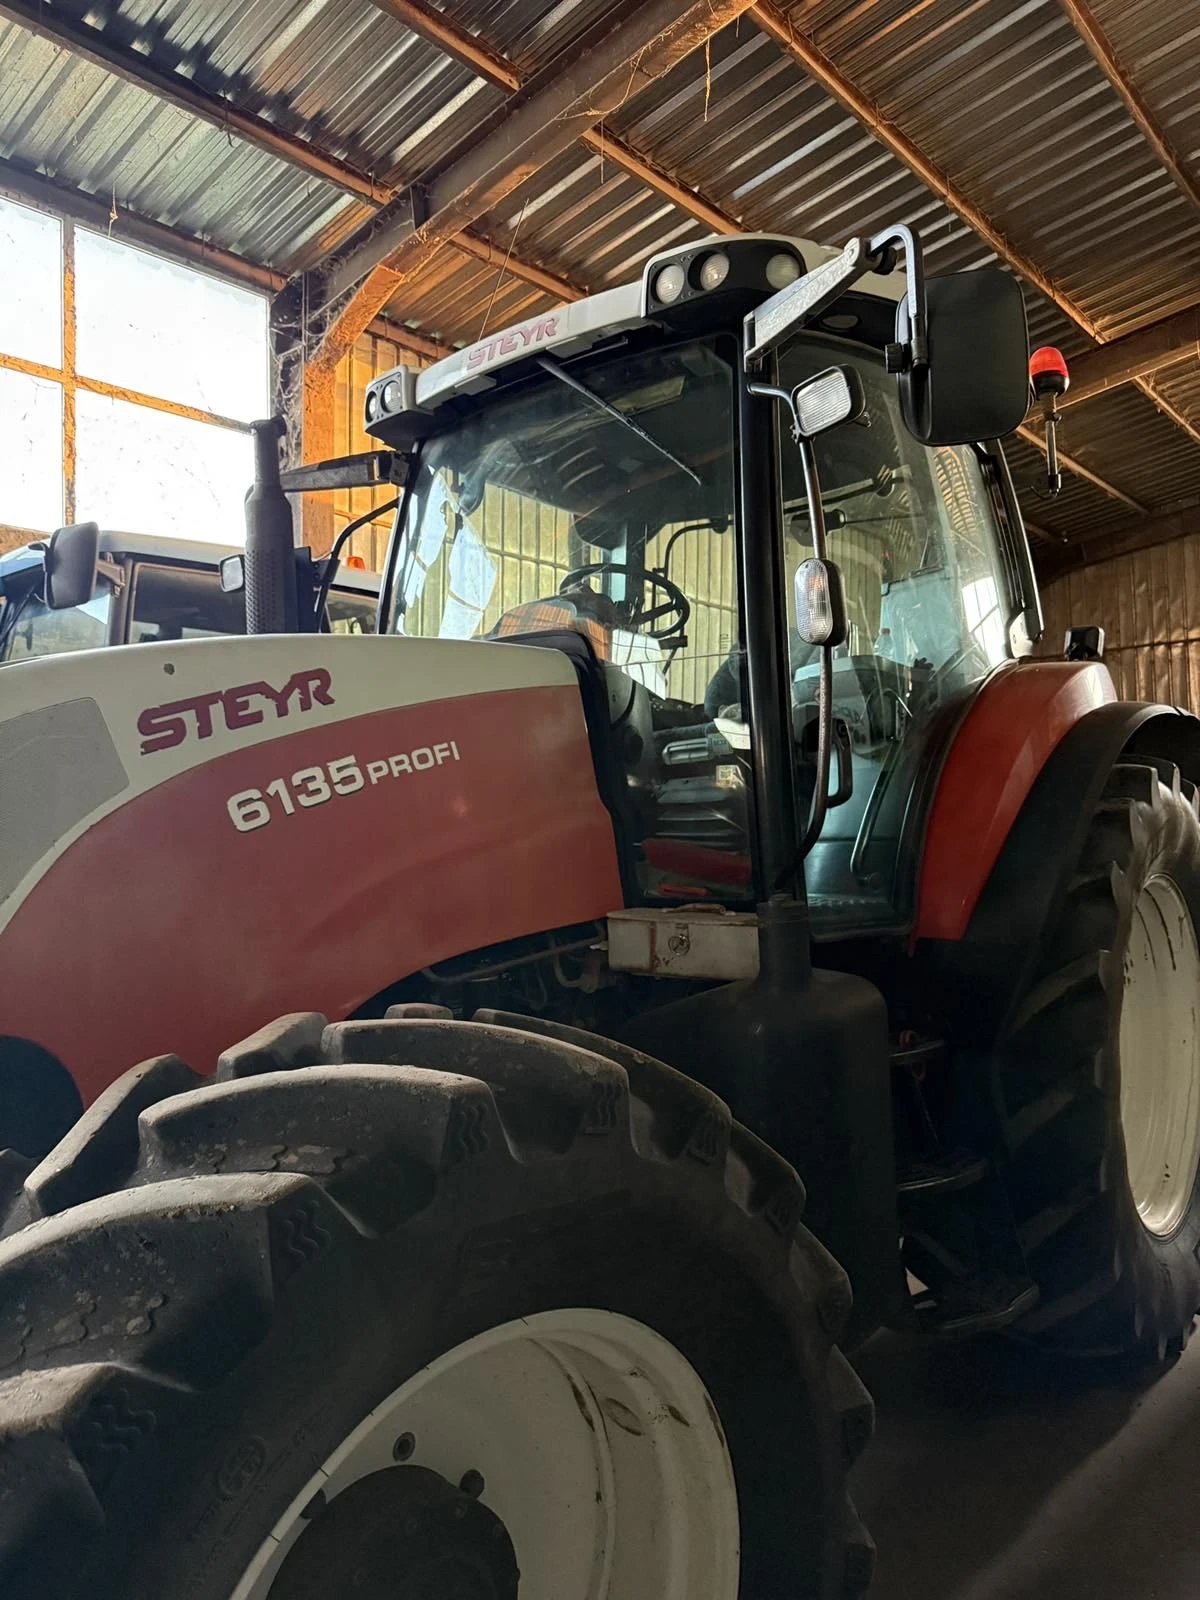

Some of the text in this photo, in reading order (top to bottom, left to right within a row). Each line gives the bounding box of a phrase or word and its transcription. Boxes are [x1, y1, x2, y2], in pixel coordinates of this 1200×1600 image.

[466, 317, 560, 370] STEYR
[137, 668, 335, 756] STEYR
[227, 741, 461, 832] 6135 PROFI
